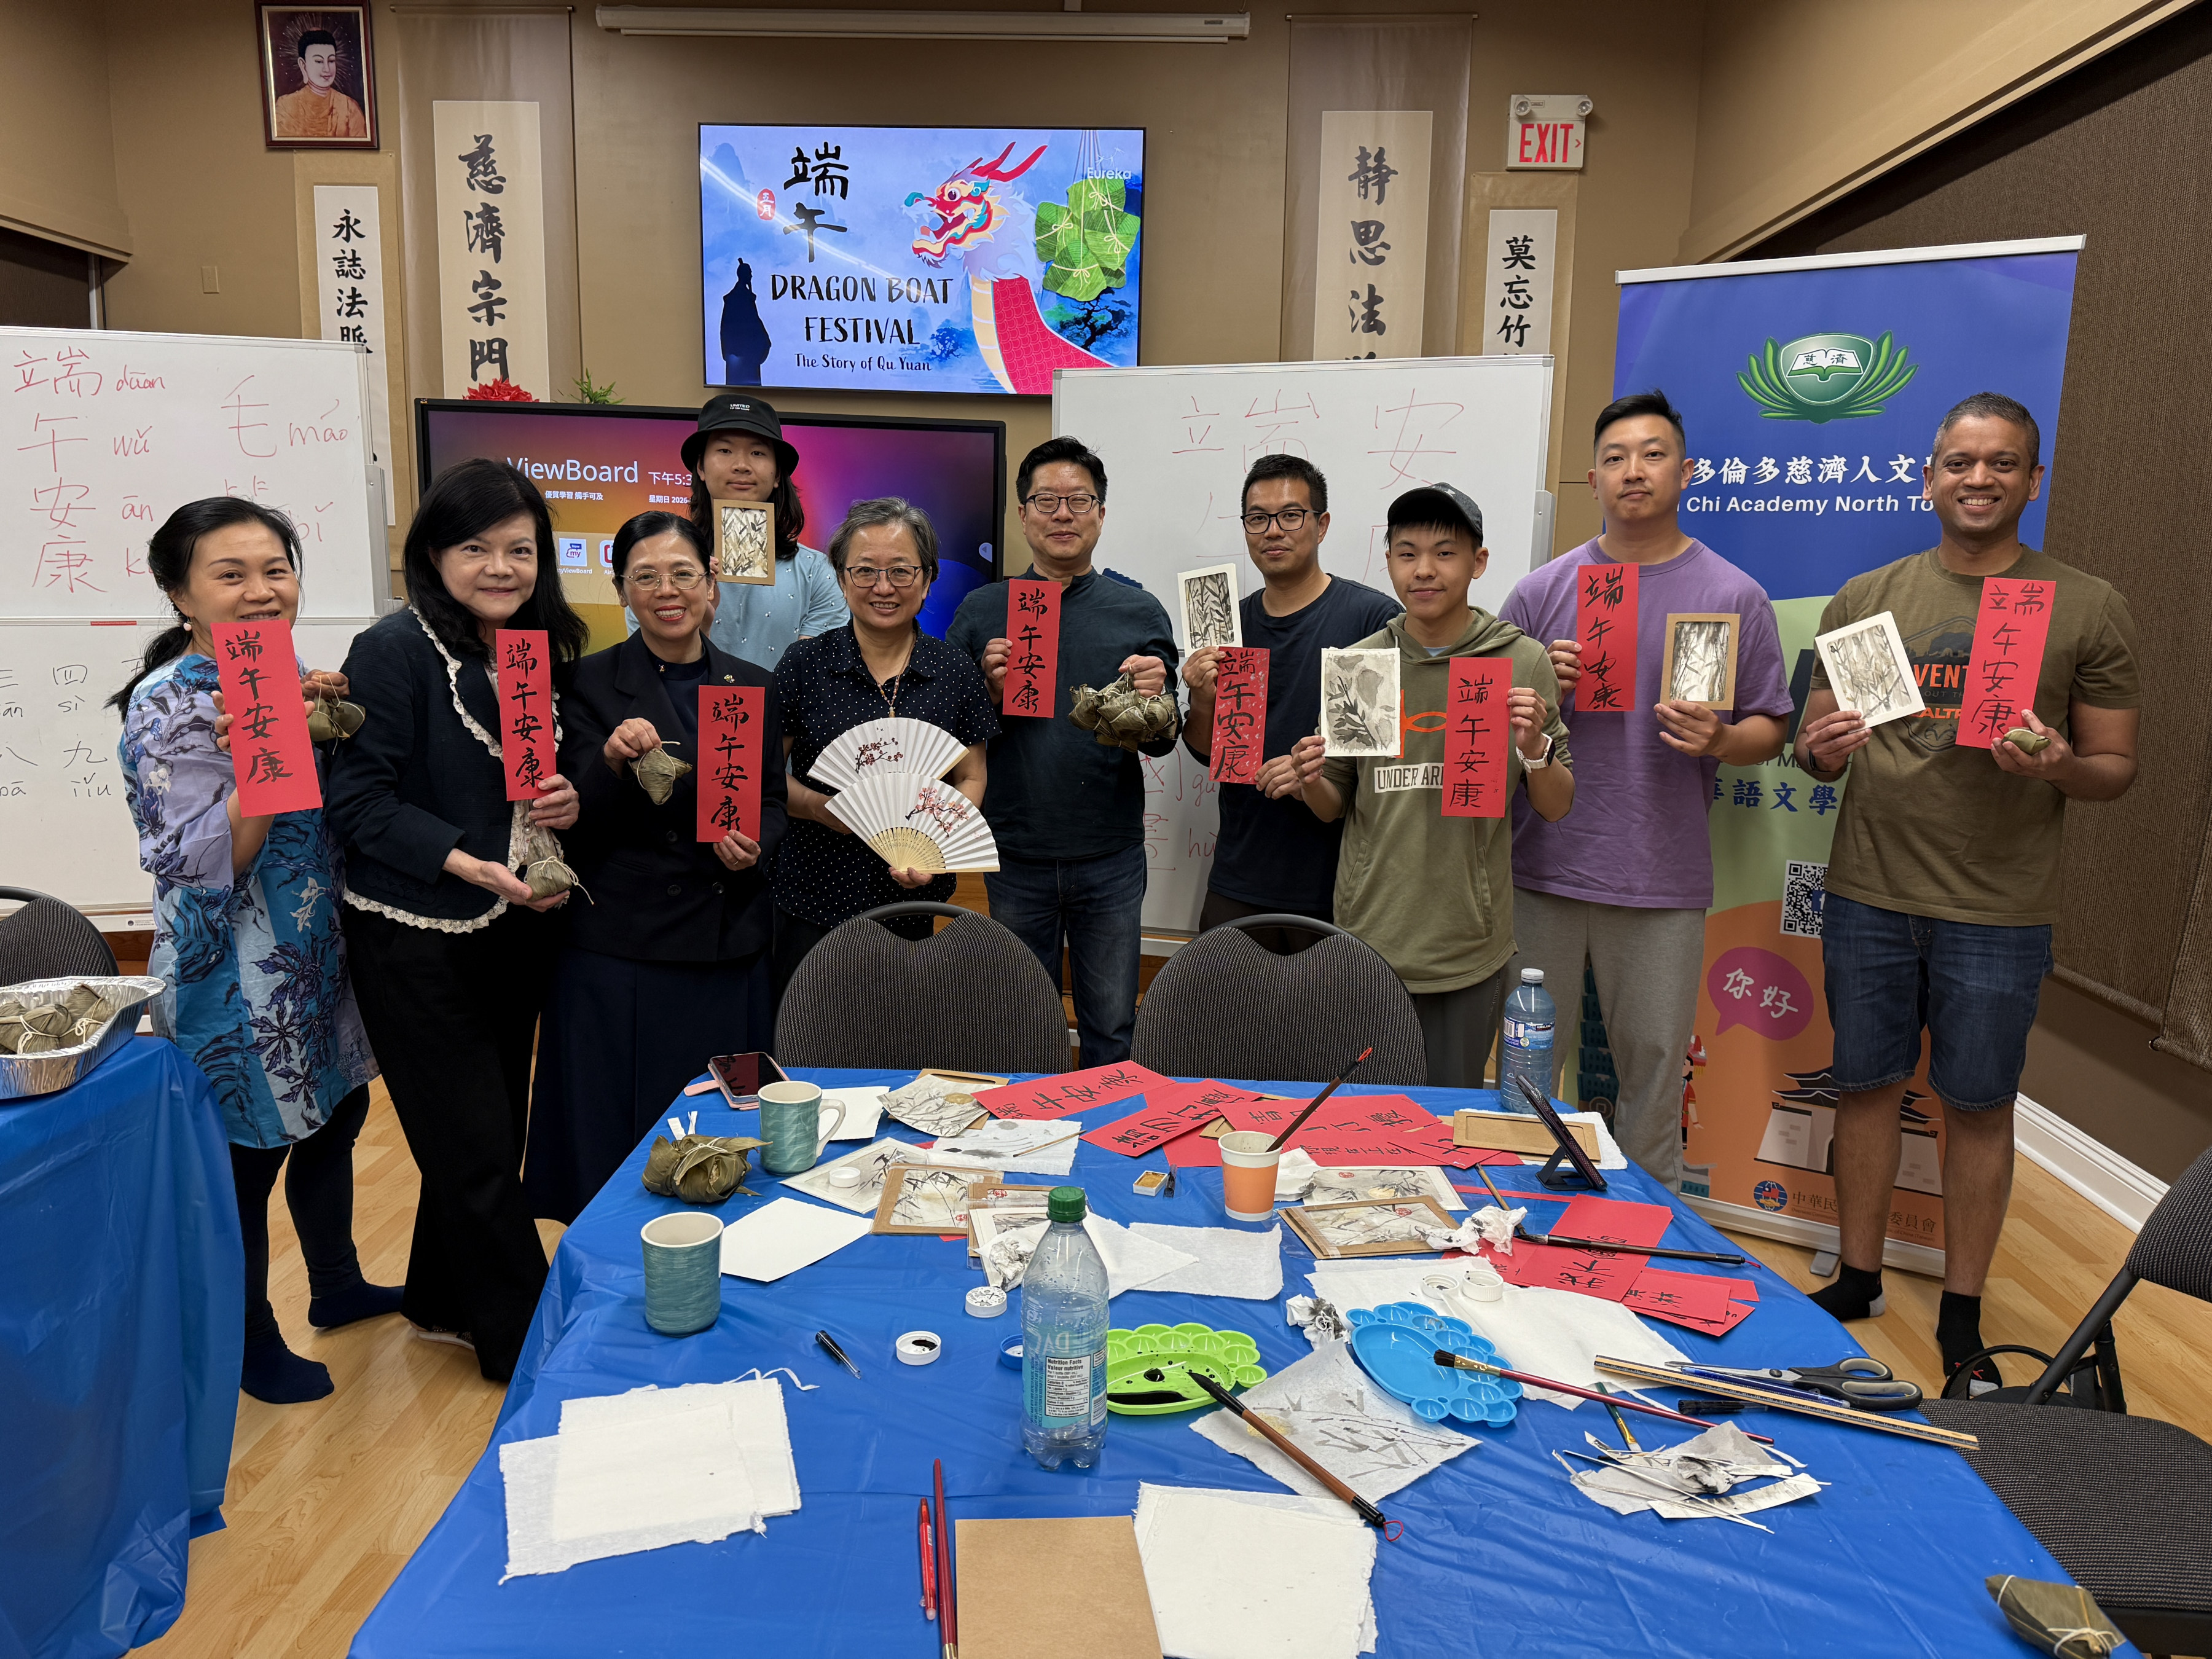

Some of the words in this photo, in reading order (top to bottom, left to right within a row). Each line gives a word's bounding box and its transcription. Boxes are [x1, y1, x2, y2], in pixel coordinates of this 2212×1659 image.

[1519, 124, 1574, 163] EXIT
[783, 142, 849, 262] 端午
[1087, 167, 1132, 180] Eureka
[759, 192, 775, 218] 五月
[458, 134, 509, 382] 慈濟宗門
[1344, 146, 1398, 360] 靜思法
[771, 275, 876, 302] DRAGON
[885, 277, 954, 304] BOAT
[1496, 235, 1536, 356] 莫忘竹
[805, 316, 920, 345] FESTIVAL
[1803, 353, 1849, 366] 慈濟
[14, 346, 101, 397] 端
[794, 353, 819, 367] The
[822, 354, 856, 372] Story
[860, 357, 873, 370] of
[877, 356, 896, 371] Qu
[899, 356, 932, 371] Yuan
[17, 413, 88, 473] 午
[221, 375, 276, 457] 毛
[1691, 453, 1933, 485] 多倫多慈濟人文
[29, 477, 96, 530] 安
[1687, 496, 1720, 512] Chi
[1726, 496, 1829, 516] Academy
[1835, 495, 1899, 512] North
[32, 535, 109, 593] 康
[1012, 587, 1048, 713] 端午安康
[1583, 566, 1624, 709] 端午安康
[1971, 583, 2045, 739] 端午安康
[226, 630, 294, 784] 端午安康
[506, 638, 544, 788] 端午安康
[1214, 651, 1257, 780] 端午安康
[63, 740, 108, 769] 九
[710, 693, 750, 831] 端午安康
[1449, 673, 1494, 808] 端午安康
[1378, 768, 1419, 790] UNDER
[1722, 968, 1798, 1019] 你好
